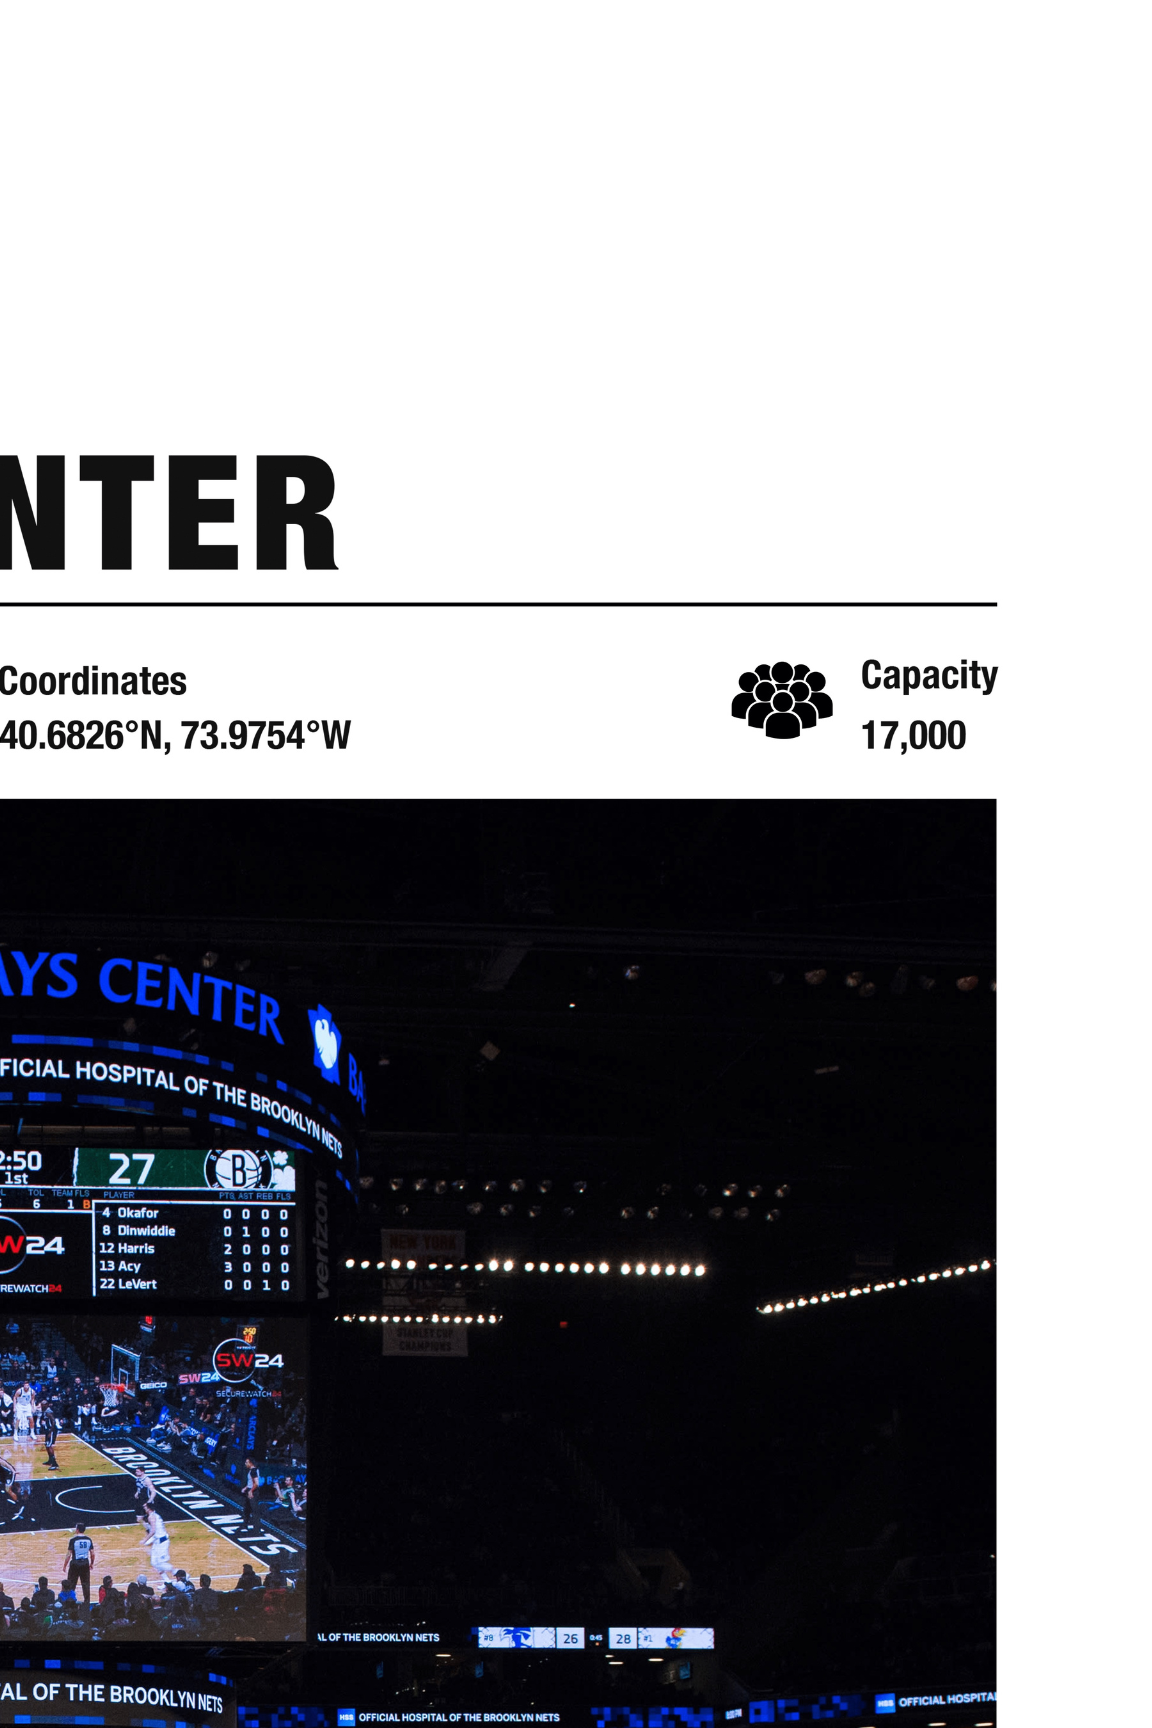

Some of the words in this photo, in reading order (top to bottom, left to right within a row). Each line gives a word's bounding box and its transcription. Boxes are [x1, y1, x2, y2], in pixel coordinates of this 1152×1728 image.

[99, 958, 285, 1045] CENTER
[76, 1061, 180, 1092] HOSPITAL
[184, 1075, 209, 1096] OF
[212, 1081, 247, 1107] THE
[250, 1092, 320, 1142] BROOKLYN
[321, 1131, 343, 1160] NETS
[109, 1153, 155, 1185] 27
[5, 1172, 29, 1185] 1st
[103, 1191, 135, 1199] PLAYER
[102, 1207, 110, 1218] 4
[118, 1207, 159, 1219] Okafor
[102, 1225, 111, 1236] 8
[118, 1225, 176, 1237] Dinwiddie
[312, 1179, 330, 1300] verizon
[99, 1243, 115, 1254] 12
[118, 1243, 155, 1254] Harris
[99, 1260, 115, 1272] 13
[118, 1261, 142, 1274] Acy
[99, 1278, 115, 1289] 22
[118, 1278, 158, 1290] LeVert
[216, 1353, 284, 1368] SW24
[179, 1372, 221, 1385] SW24
[563, 1633, 579, 1645] 26
[616, 1633, 631, 1645] 28
[32, 1682, 61, 1701] OF
[65, 1683, 105, 1702] THE
[110, 1685, 196, 1709] BROOKLYN
[198, 1694, 223, 1713] NETS
[898, 1694, 946, 1708] OFFICIAL
